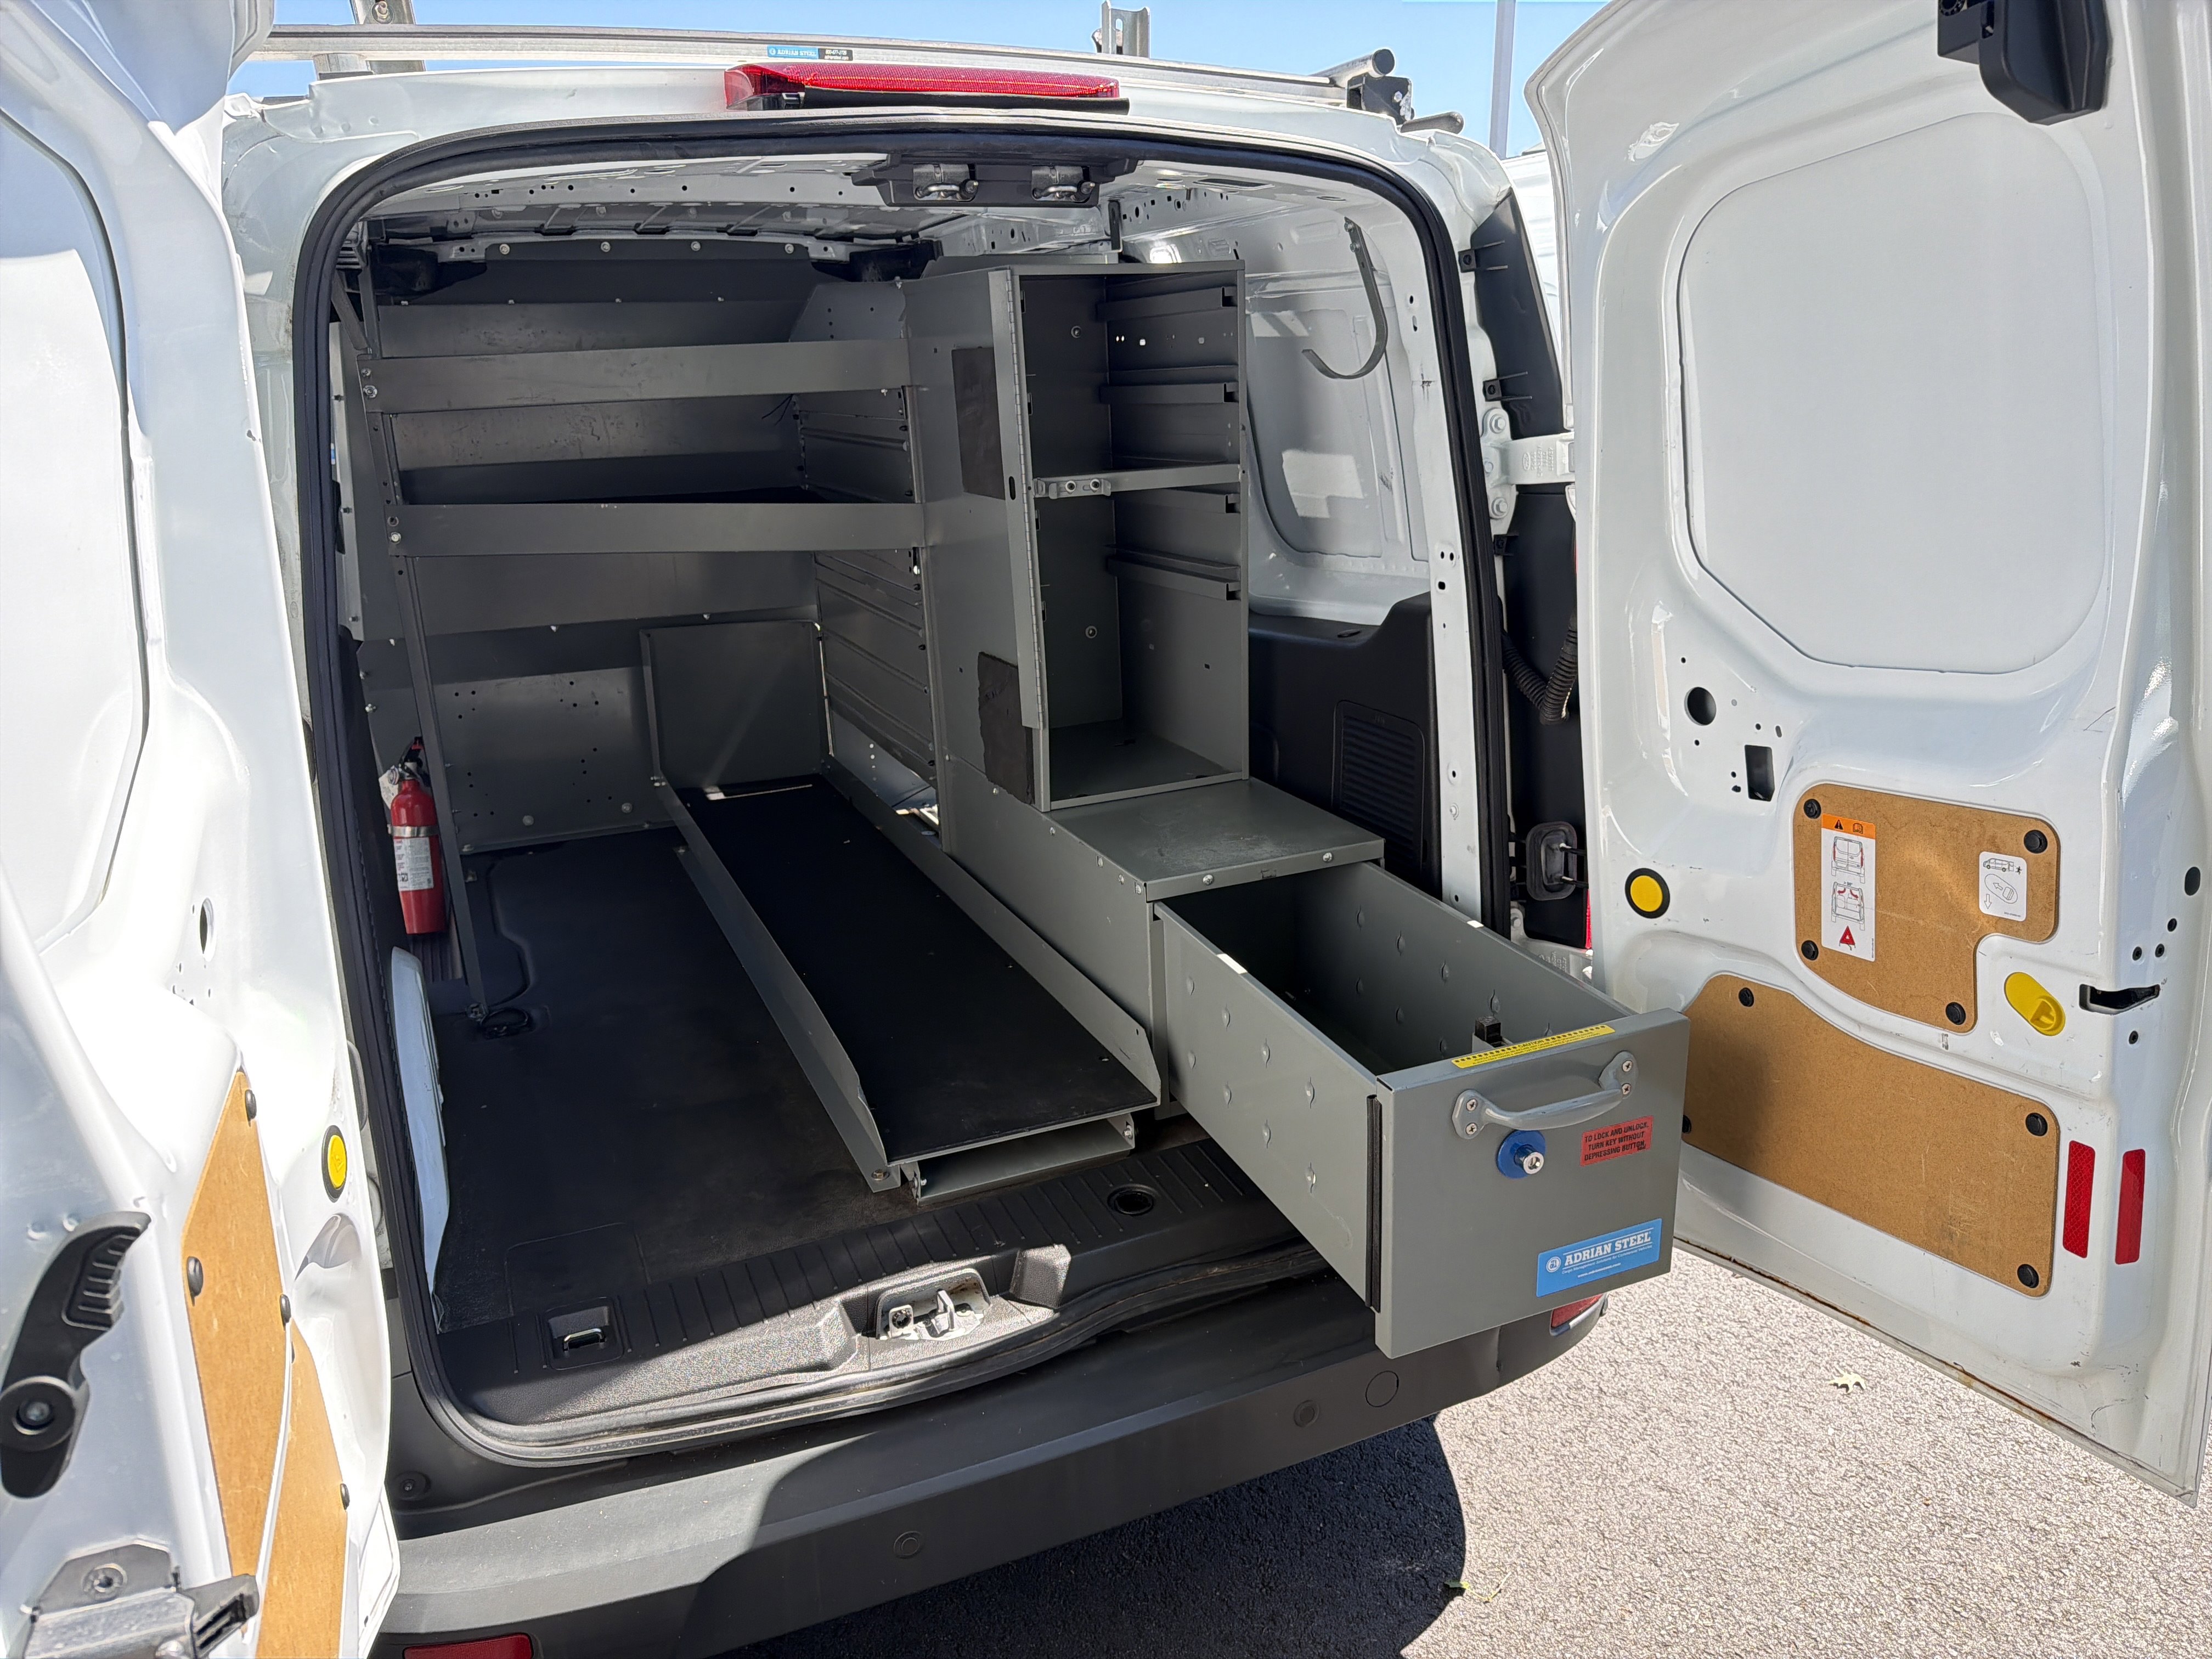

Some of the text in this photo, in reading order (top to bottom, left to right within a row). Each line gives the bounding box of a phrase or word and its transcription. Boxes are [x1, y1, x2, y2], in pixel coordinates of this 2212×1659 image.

[1517, 1039, 1545, 1048] CAUTION
[1588, 1131, 1645, 1151] TURN KEY WITHOUT
[1594, 1131, 1609, 1141] LOCK
[1610, 1127, 1622, 1137] AND
[1584, 1146, 1621, 1161] DEPRESSING
[1564, 1231, 1651, 1266] ADRIAN STEEL
[1573, 1261, 1596, 1271] Management
